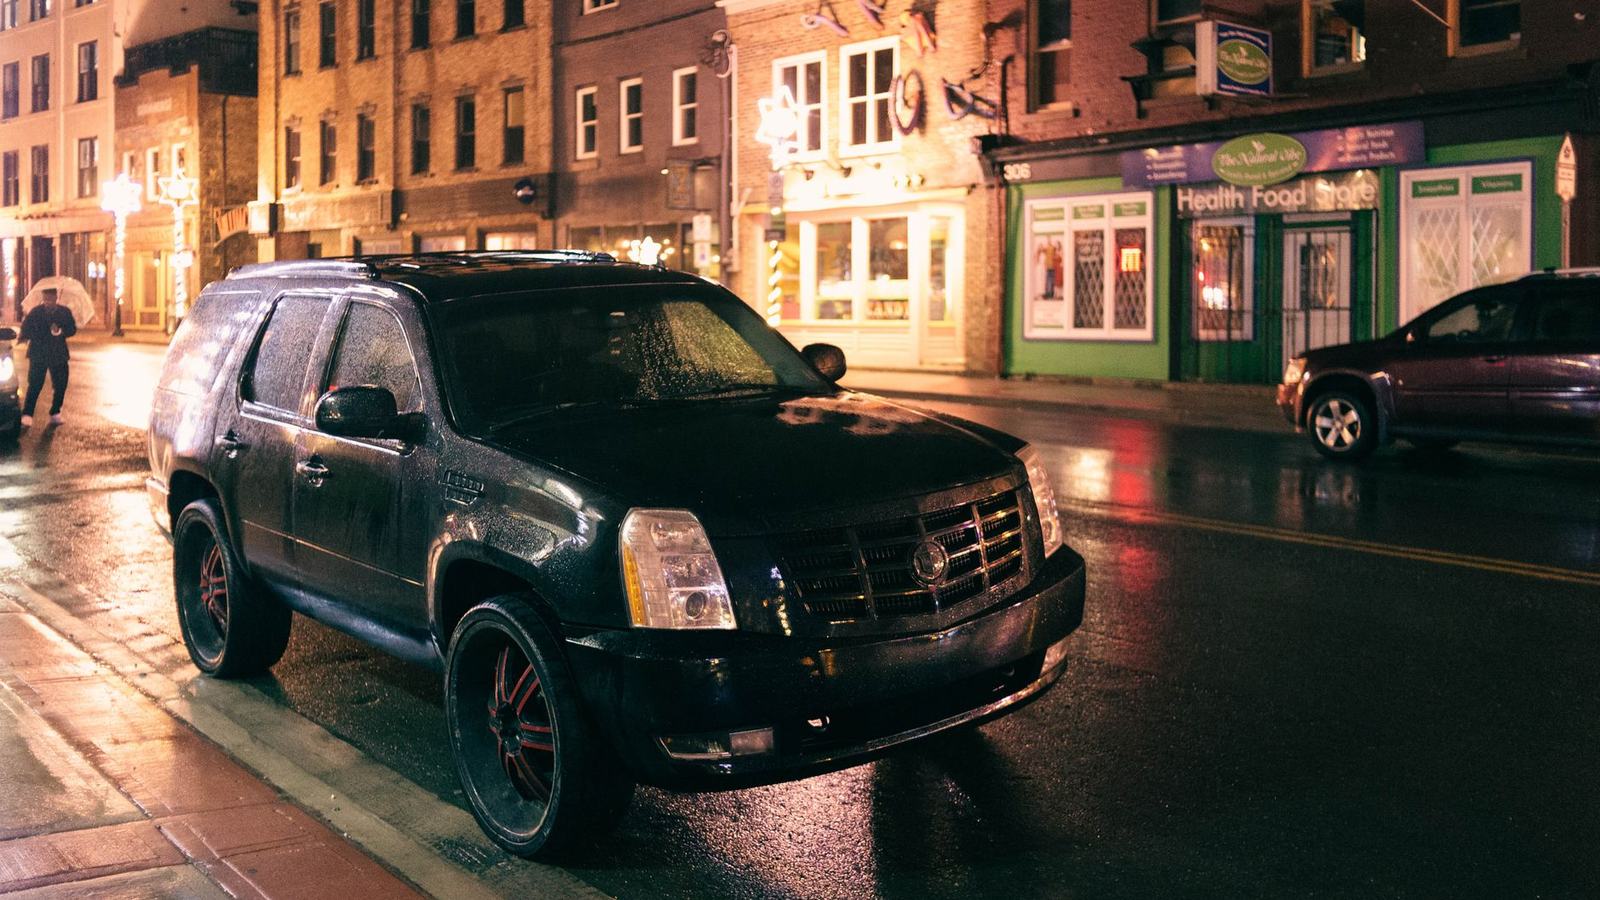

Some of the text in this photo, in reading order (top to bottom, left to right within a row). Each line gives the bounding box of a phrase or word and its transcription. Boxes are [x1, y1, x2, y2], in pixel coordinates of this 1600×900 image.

[1238, 150, 1278, 167] Natural
[1003, 163, 1031, 180] 306
[1177, 177, 1375, 211] Health Food Store
